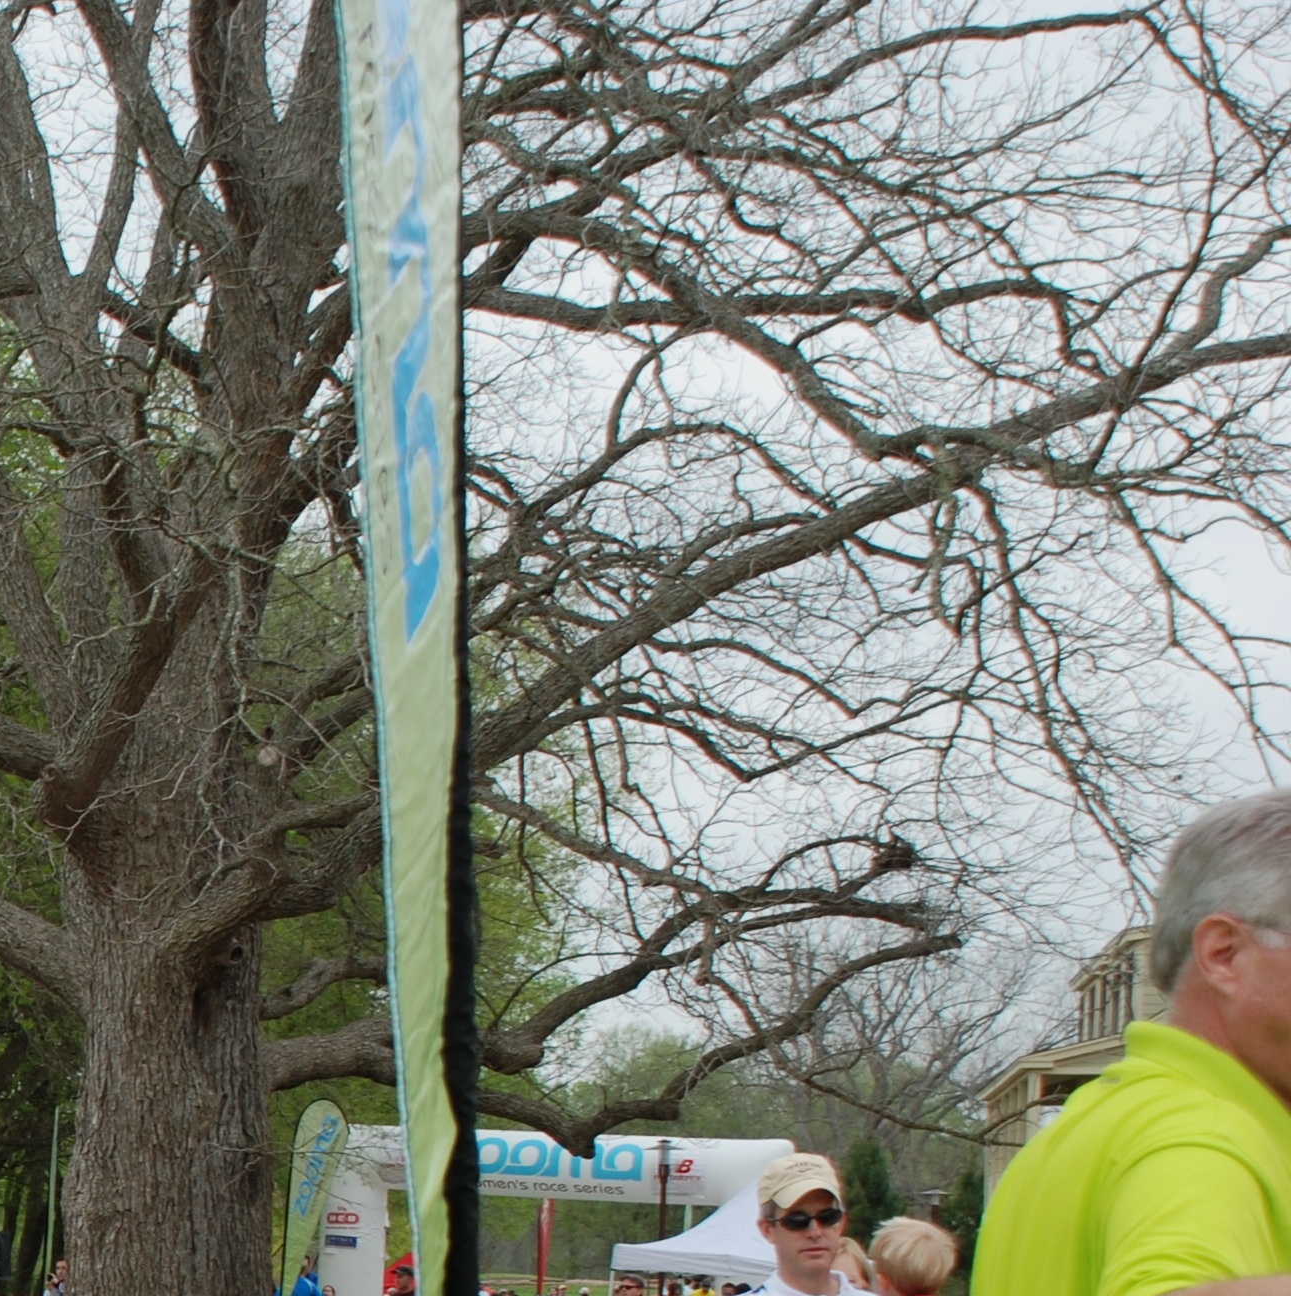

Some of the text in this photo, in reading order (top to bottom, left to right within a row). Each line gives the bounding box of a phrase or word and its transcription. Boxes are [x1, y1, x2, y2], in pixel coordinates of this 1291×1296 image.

[292, 1115, 340, 1217] zooma
[477, 1137, 643, 1181] ooma
[533, 1182, 568, 1192] race
[573, 1182, 625, 1196] series
